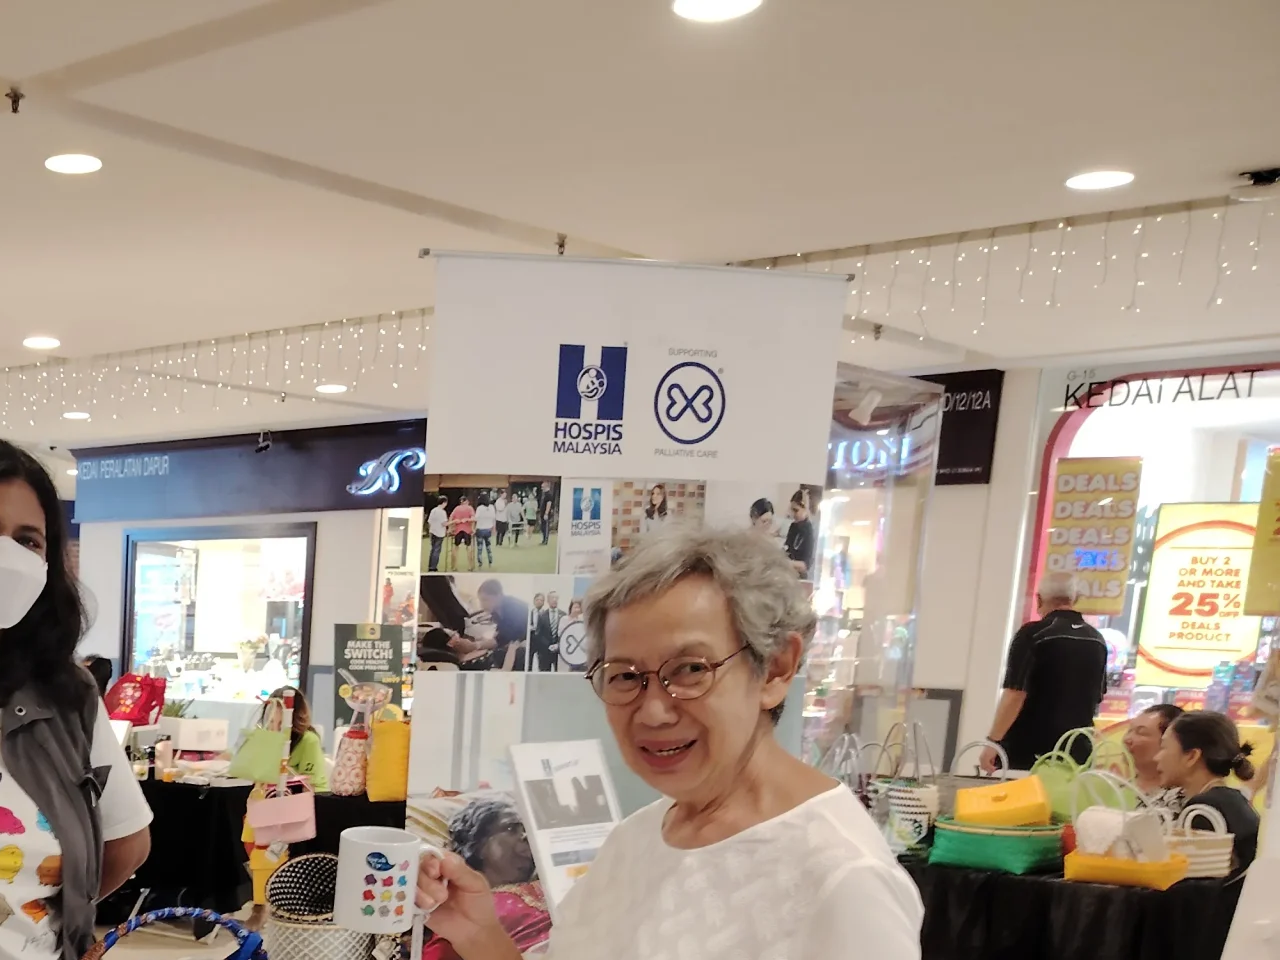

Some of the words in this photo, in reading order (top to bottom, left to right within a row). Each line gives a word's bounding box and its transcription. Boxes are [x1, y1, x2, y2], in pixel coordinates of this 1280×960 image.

[668, 348, 718, 359] SUPPORTING
[1172, 368, 1264, 403] ALAT
[554, 422, 623, 441] HOSPIS
[553, 441, 623, 455] MALAYSIA
[654, 449, 695, 457] PALLIATIVE
[696, 450, 718, 459] CARE
[143, 455, 169, 476] DAPUR
[1058, 472, 1138, 492] DEALS
[1054, 500, 1134, 519] DEALS
[571, 521, 601, 530] HOSPIS
[1051, 527, 1130, 545] DEALS
[1191, 556, 1218, 565] BUY
[1179, 568, 1197, 576] OR
[1201, 568, 1241, 577] MORE
[1074, 580, 1122, 598] ALS
[1177, 580, 1206, 588] AND
[1210, 580, 1241, 589] TAKE
[1181, 622, 1220, 630] DEALS
[1168, 632, 1231, 642] PRODUCT
[347, 641, 372, 649] MAKE
[374, 640, 391, 649] THE
[344, 649, 393, 659] SWITCH!
